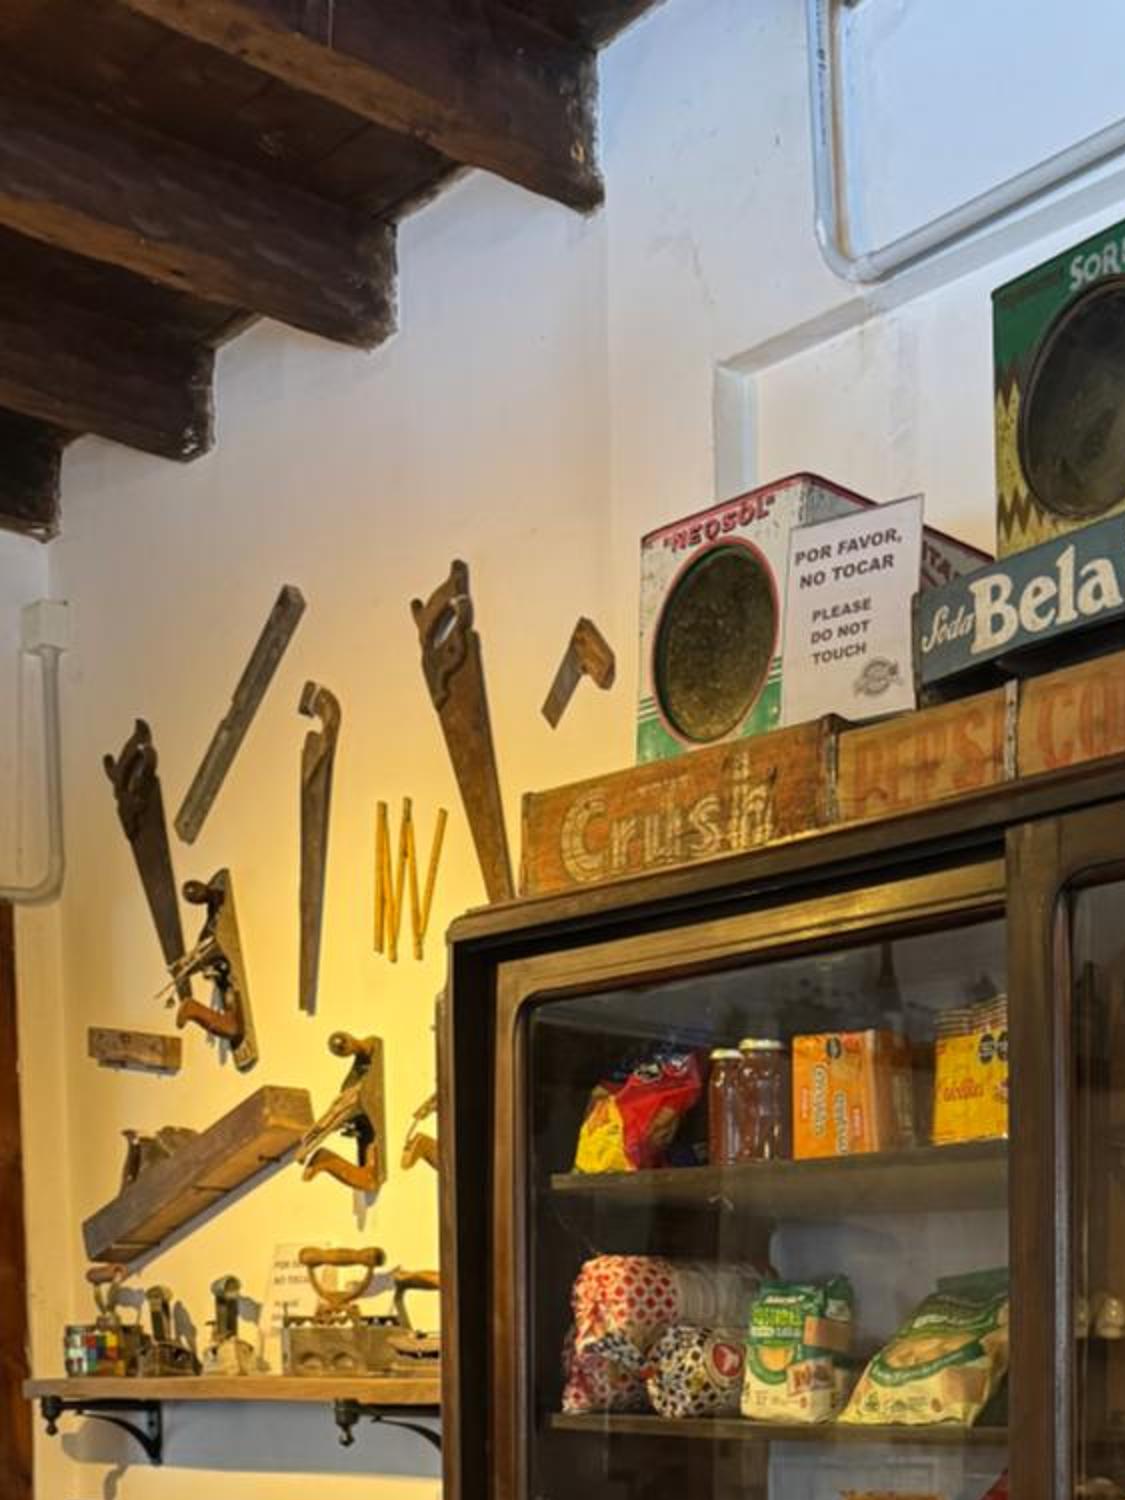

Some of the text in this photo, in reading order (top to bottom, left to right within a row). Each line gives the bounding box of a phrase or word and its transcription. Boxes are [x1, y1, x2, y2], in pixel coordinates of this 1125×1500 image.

[794, 527, 902, 567] POR FAVOR,
[800, 553, 895, 589] NO TOCAR
[811, 598, 872, 623] PLEASE
[810, 619, 871, 645] DO NOT
[812, 642, 867, 666] TOUCH
[560, 752, 778, 883] Crush
